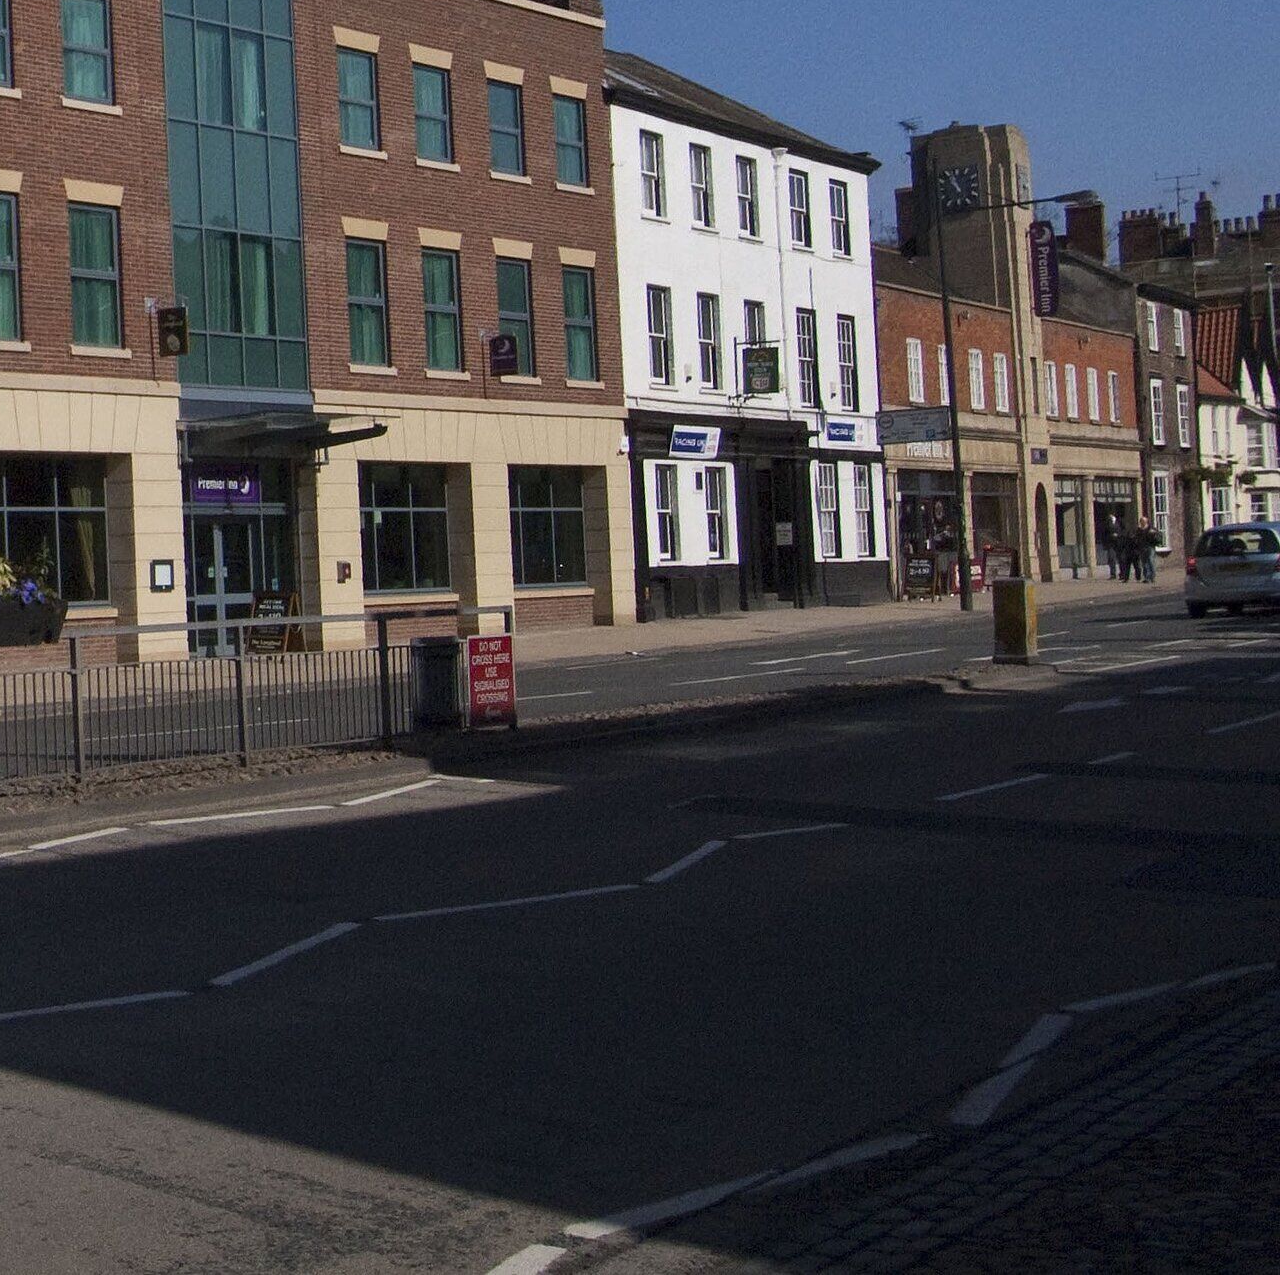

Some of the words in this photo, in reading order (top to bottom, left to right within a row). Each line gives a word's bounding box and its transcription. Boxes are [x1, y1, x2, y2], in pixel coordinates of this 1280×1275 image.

[1037, 246, 1050, 292] Premier
[1040, 293, 1052, 314] Inn
[197, 477, 225, 490] Premier
[479, 642, 488, 652] DO
[489, 640, 501, 651] NOT
[472, 654, 493, 665] CROSS
[494, 652, 510, 664] HERE
[485, 666, 497, 677] USE
[477, 691, 508, 704] CROSSING
